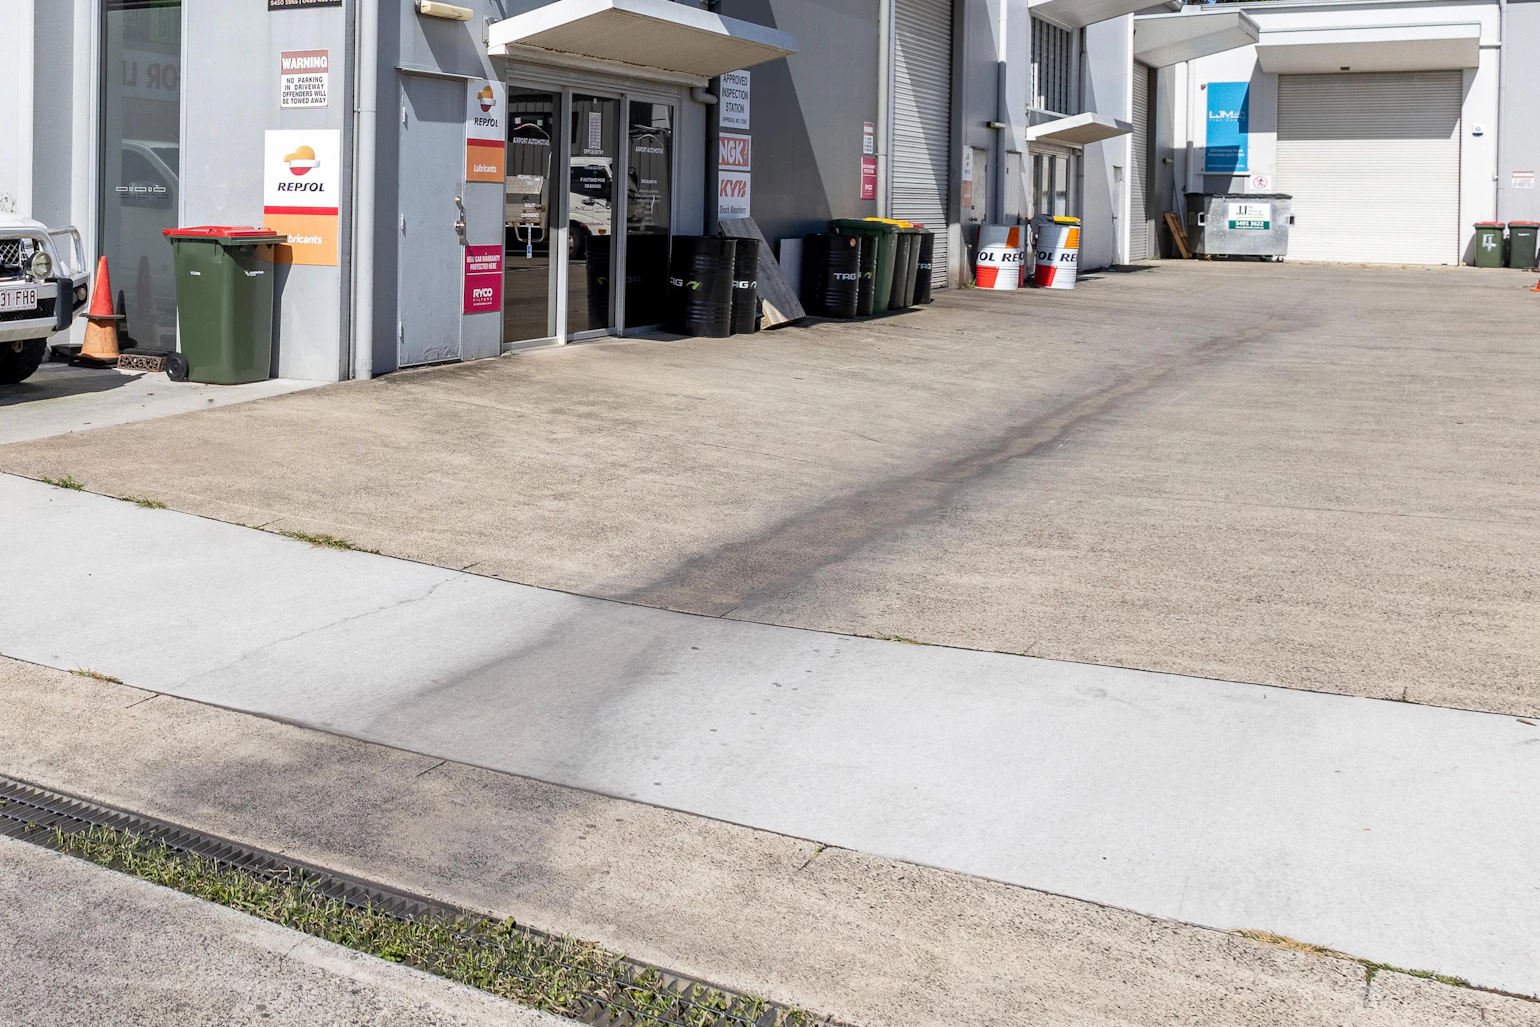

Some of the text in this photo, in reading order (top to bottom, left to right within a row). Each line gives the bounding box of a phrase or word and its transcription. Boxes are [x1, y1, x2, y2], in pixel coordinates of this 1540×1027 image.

[282, 56, 328, 69] WARNING
[723, 74, 748, 86] APPROVED
[294, 83, 324, 91] DRIVEWAY
[282, 90, 313, 98] OFFENDERS
[722, 87, 748, 101] INSPECTION
[725, 102, 744, 113] STATION
[1209, 110, 1234, 119] LJM
[474, 117, 498, 128] REPSOL
[528, 138, 549, 146] AUTOMOTIVE
[719, 139, 744, 165] NGK
[473, 164, 497, 173] Lubricants
[277, 182, 325, 192] REPSOL
[720, 179, 747, 198] KYB
[287, 234, 323, 244] bricants
[833, 272, 856, 280] TAG
[670, 277, 683, 287] AG
[732, 280, 749, 289] AG
[473, 288, 493, 298] RYCO
